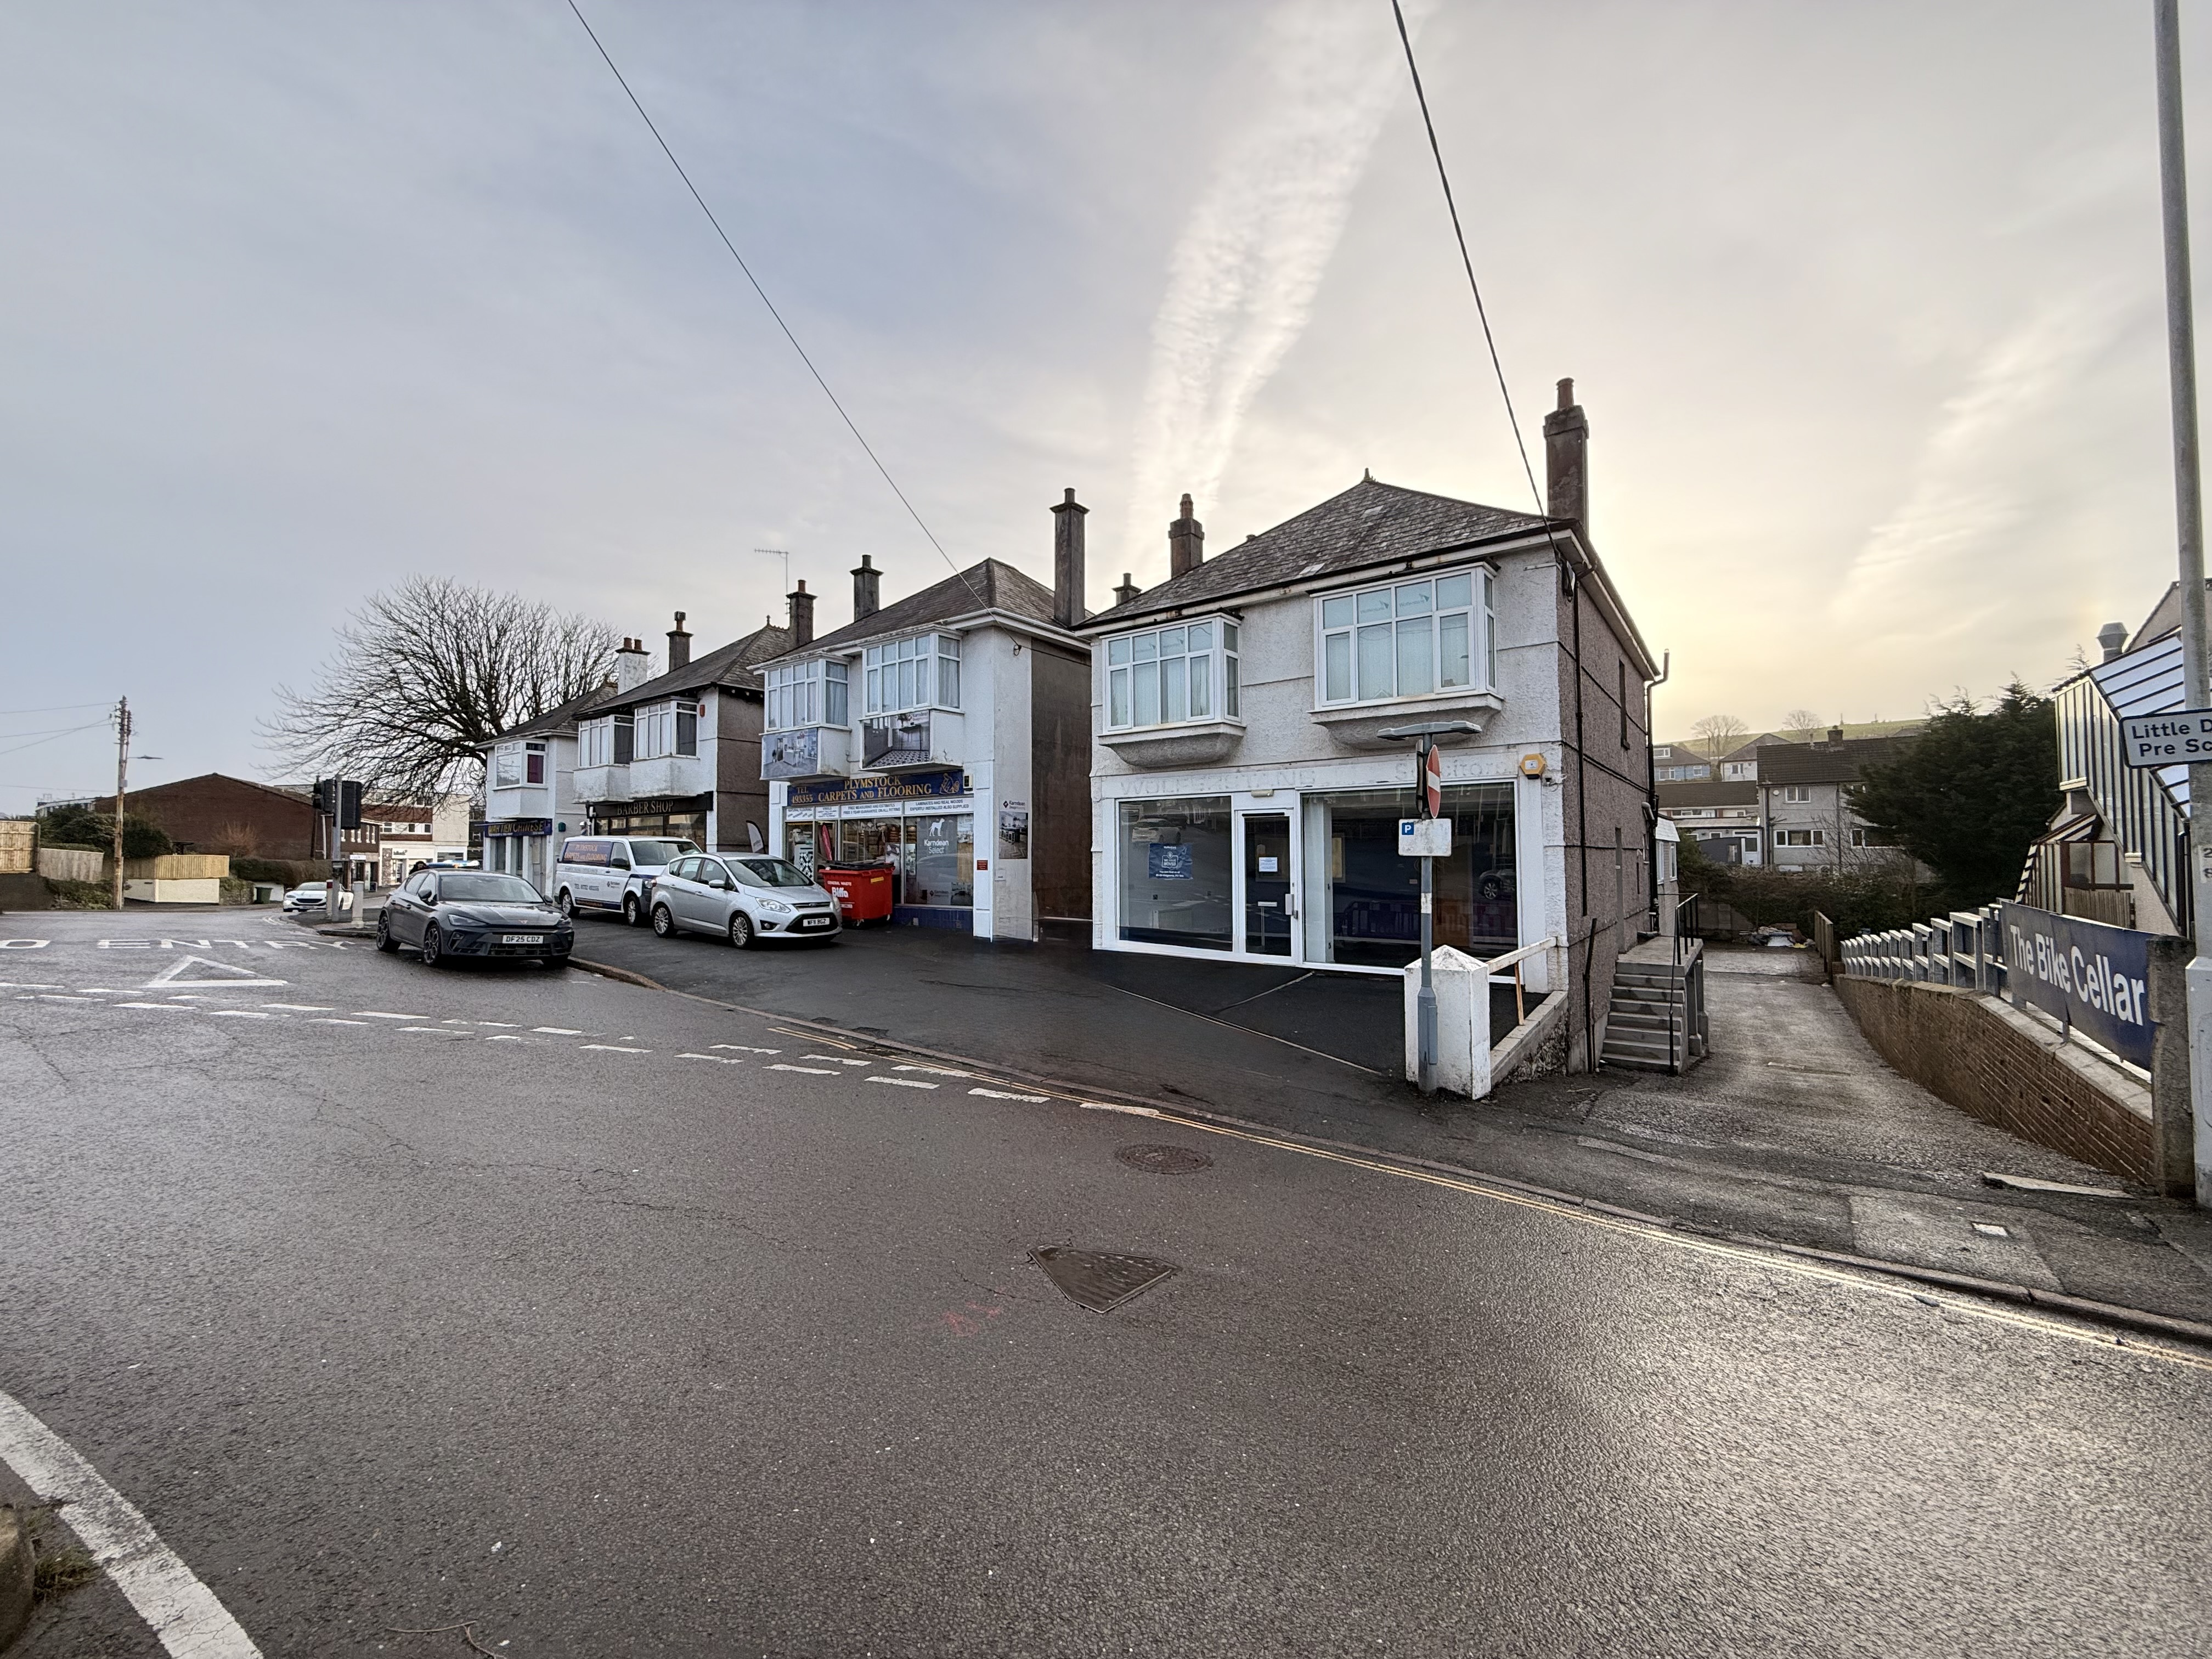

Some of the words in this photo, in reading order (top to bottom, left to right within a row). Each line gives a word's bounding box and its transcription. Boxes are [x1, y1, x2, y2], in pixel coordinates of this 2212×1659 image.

[2132, 722, 2190, 739] Little
[2139, 743, 2175, 757] Pre
[2185, 738, 2212, 753] Sc
[844, 775, 901, 790] PLYMSTOCK
[818, 789, 857, 802] CARPETS
[860, 791, 874, 799] AND
[878, 783, 932, 798] FLOORING
[617, 802, 649, 815] BARBER
[651, 800, 673, 813] SHOP
[513, 821, 543, 832] CHINESE
[1404, 825, 1412, 833] P
[832, 887, 849, 898] Biffa
[97, 939, 355, 950] ENTRY
[2010, 925, 2034, 975] The
[2035, 933, 2071, 994] Bike
[2071, 946, 2145, 1026] Cellar
